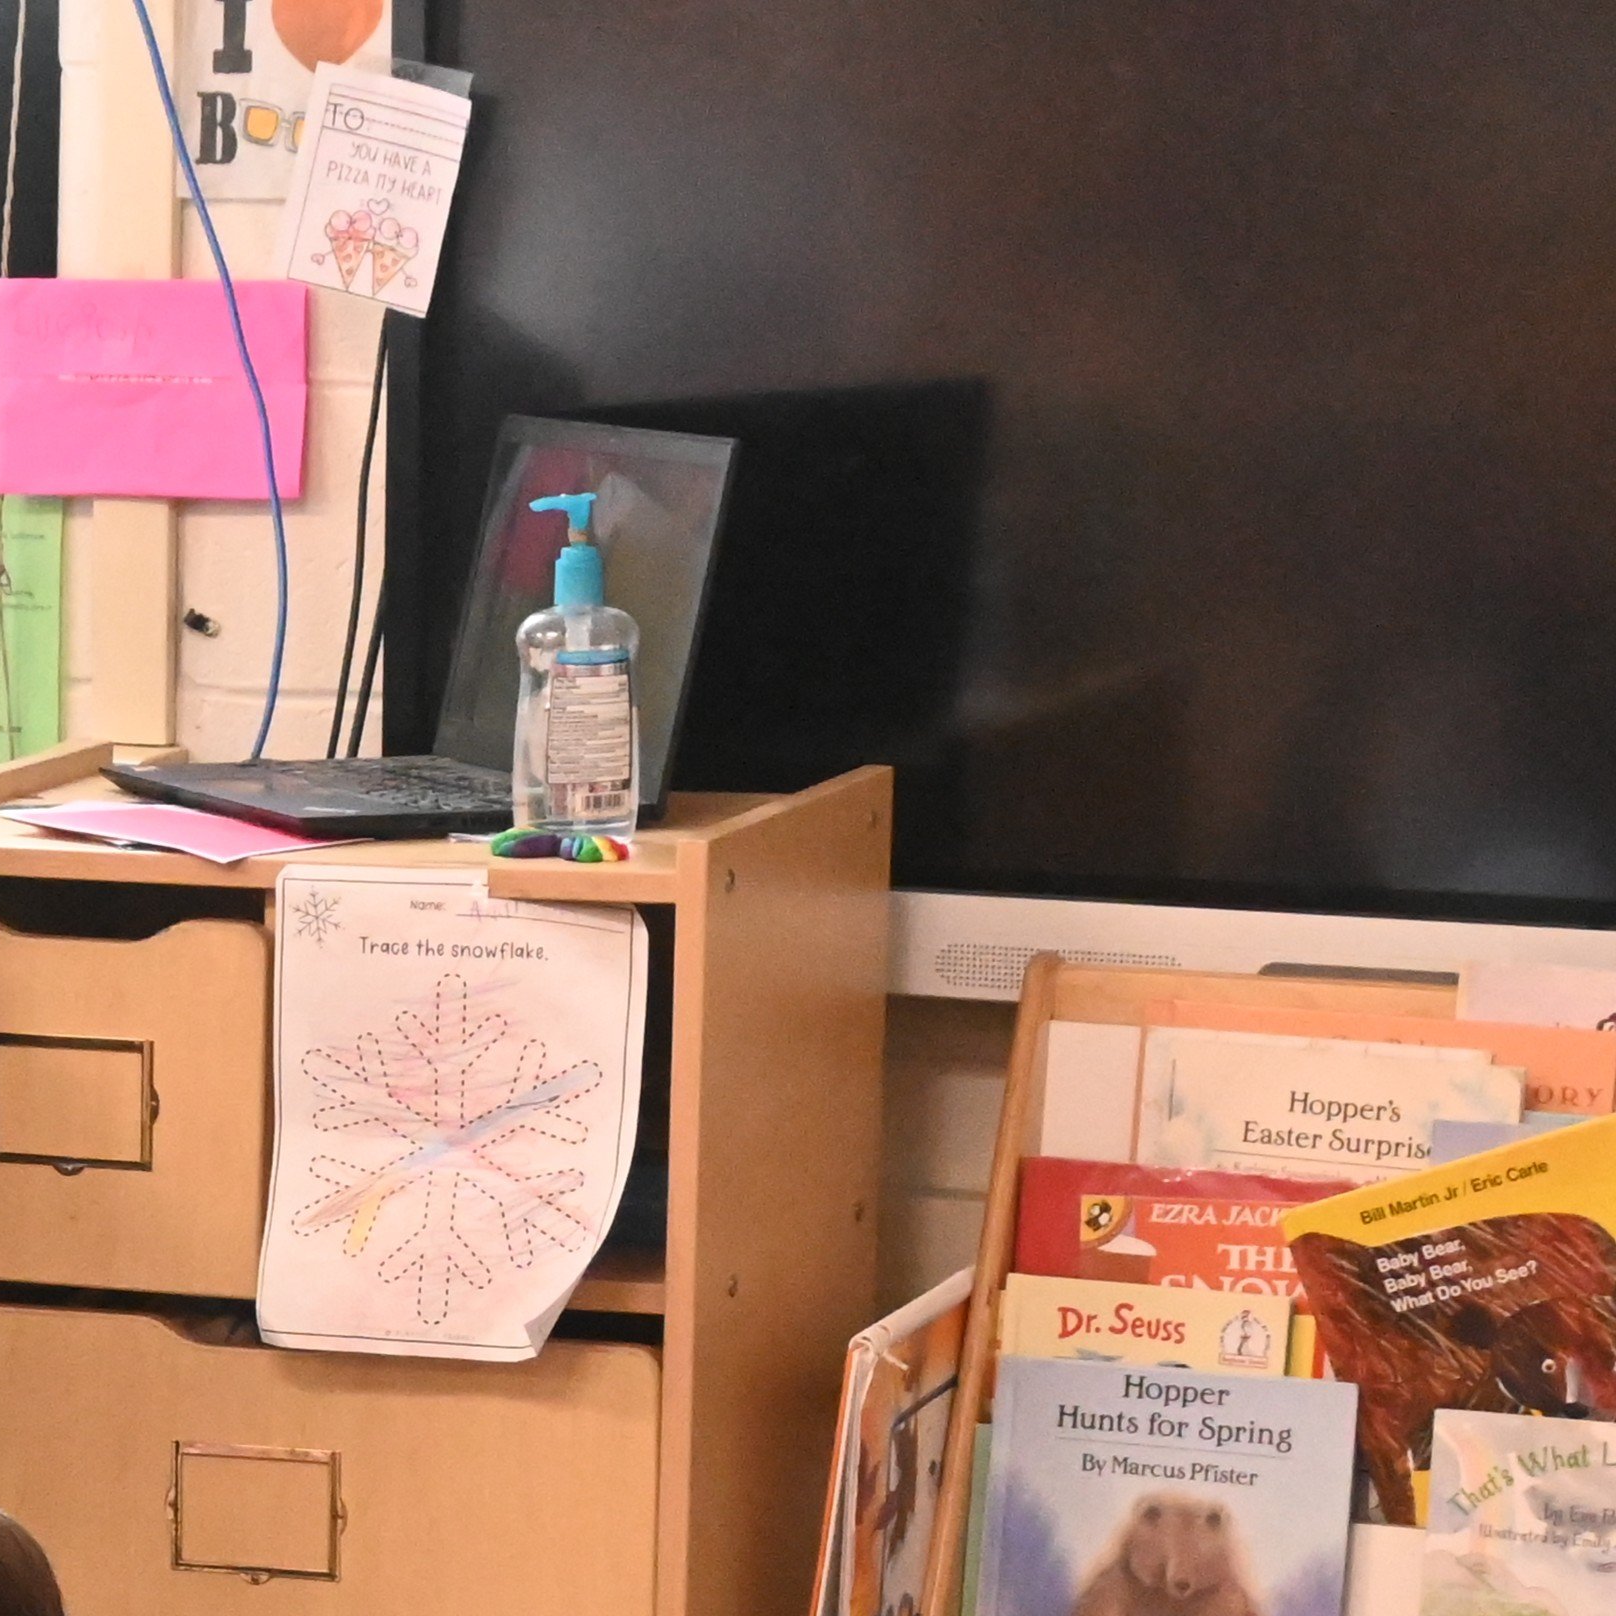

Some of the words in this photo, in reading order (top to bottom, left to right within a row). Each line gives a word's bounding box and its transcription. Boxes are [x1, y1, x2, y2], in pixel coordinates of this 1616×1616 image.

[351, 141, 380, 163] YOU
[383, 149, 419, 174] HAVE
[422, 160, 432, 177] A
[326, 160, 370, 186] PIZZA
[401, 178, 443, 206] HEART
[358, 935, 409, 956] Trace
[415, 938, 445, 957] the
[451, 940, 550, 962] snowflake.
[1287, 1090, 1401, 1124] Hopper's
[1242, 1120, 1322, 1150] Easter
[1359, 1207, 1386, 1225] Bill
[1388, 1193, 1440, 1217] Martin
[1444, 1186, 1459, 1201] Jr
[1470, 1174, 1503, 1193] Eric
[1506, 1161, 1549, 1182] Carle
[1151, 1203, 1217, 1225] EZRA
[1376, 1250, 1419, 1273] Baby
[1383, 1271, 1427, 1294] Baby
[1390, 1291, 1435, 1313] What
[1436, 1284, 1462, 1301] Do
[1460, 1275, 1494, 1292] You
[1494, 1260, 1538, 1284] See?
[1057, 1306, 1101, 1339] Dr.
[1108, 1302, 1186, 1345] Seuss
[1122, 1374, 1230, 1408] Hopper
[1056, 1404, 1140, 1435] Hunts
[1147, 1412, 1189, 1438] for
[1198, 1417, 1293, 1454] Spring
[1081, 1453, 1107, 1476] By
[1112, 1456, 1186, 1480] Marcus
[1190, 1462, 1259, 1487] Pfister
[1447, 1466, 1515, 1516] That's
[1517, 1444, 1591, 1478] What
